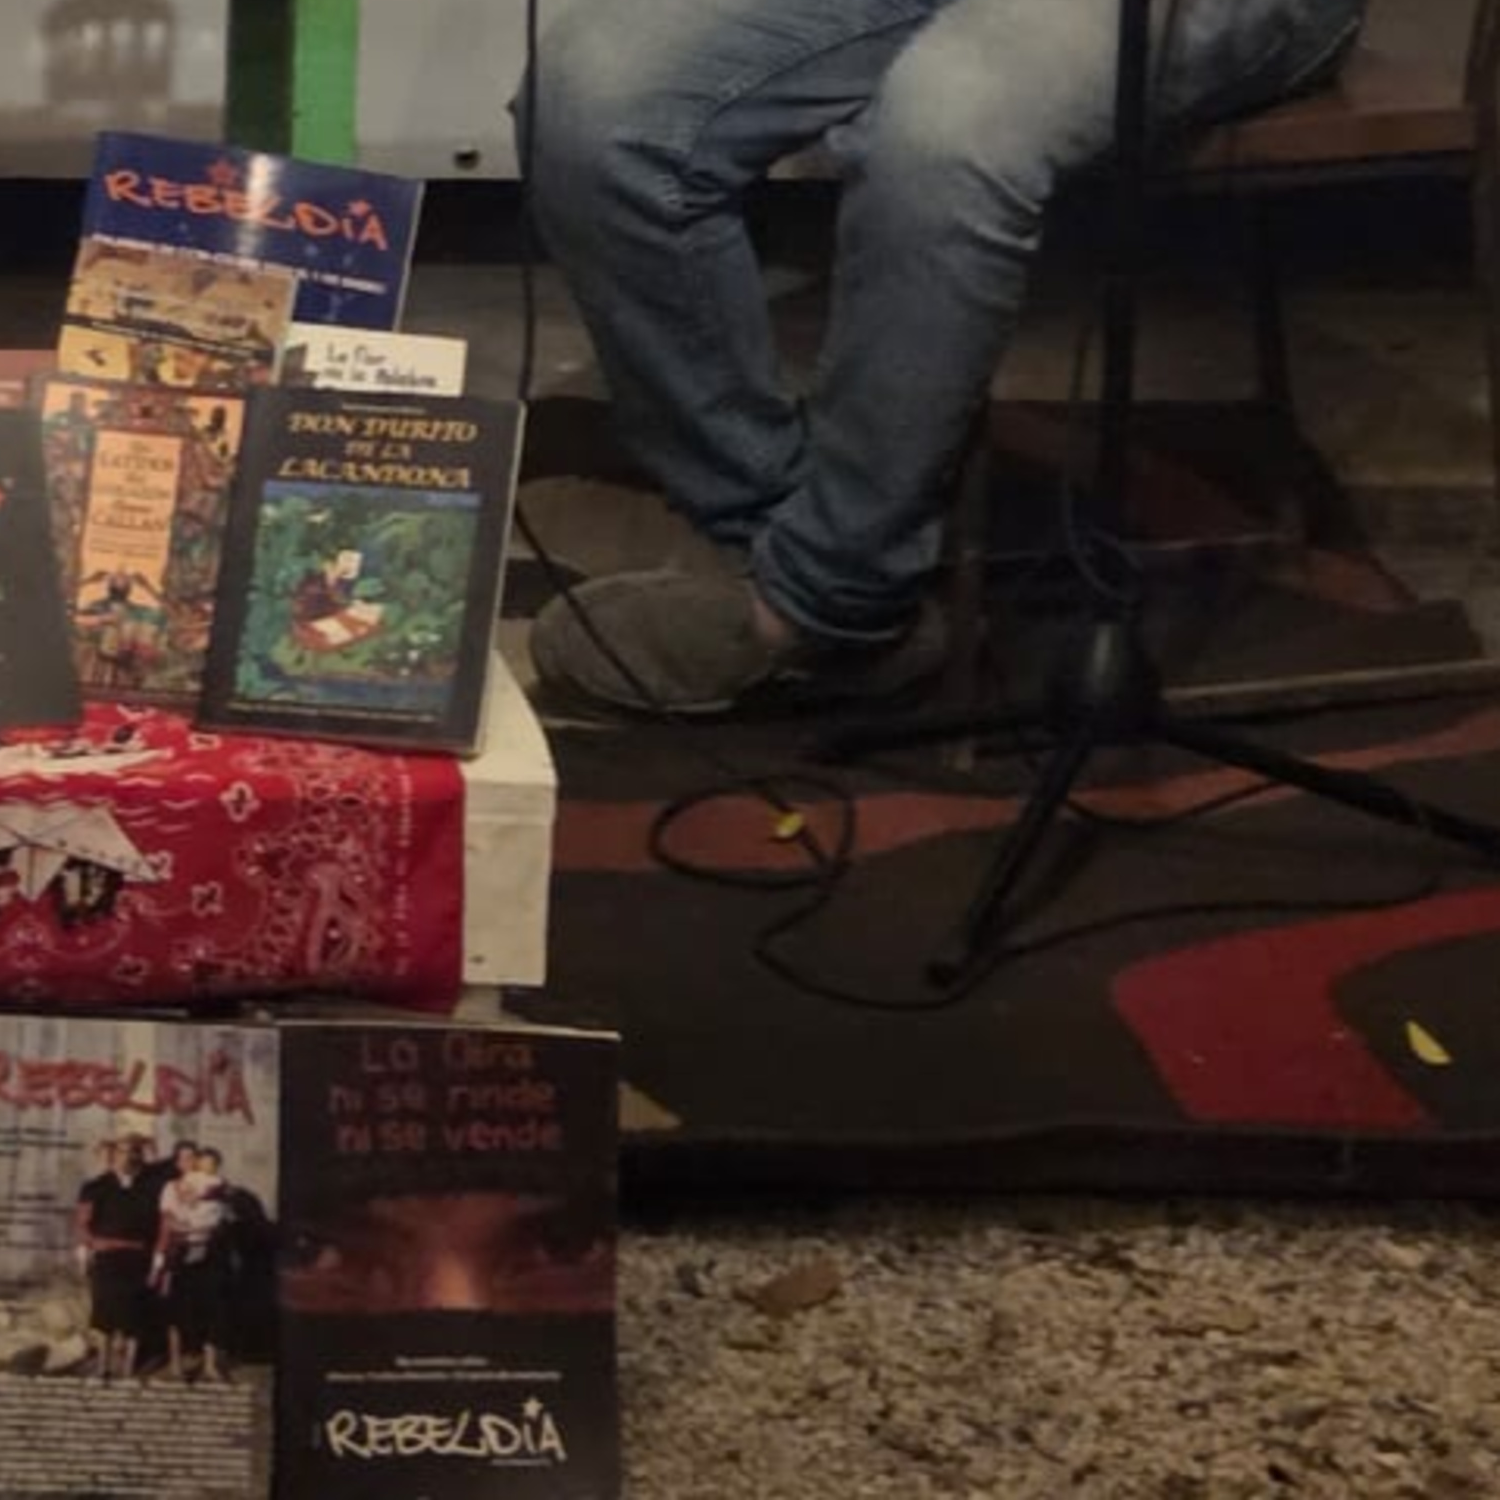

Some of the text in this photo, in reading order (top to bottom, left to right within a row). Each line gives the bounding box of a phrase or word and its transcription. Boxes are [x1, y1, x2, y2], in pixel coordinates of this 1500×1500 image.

[287, 411, 479, 442] DON DURITO
[278, 457, 470, 489] LACANDONA
[442, 1117, 563, 1151] vende
